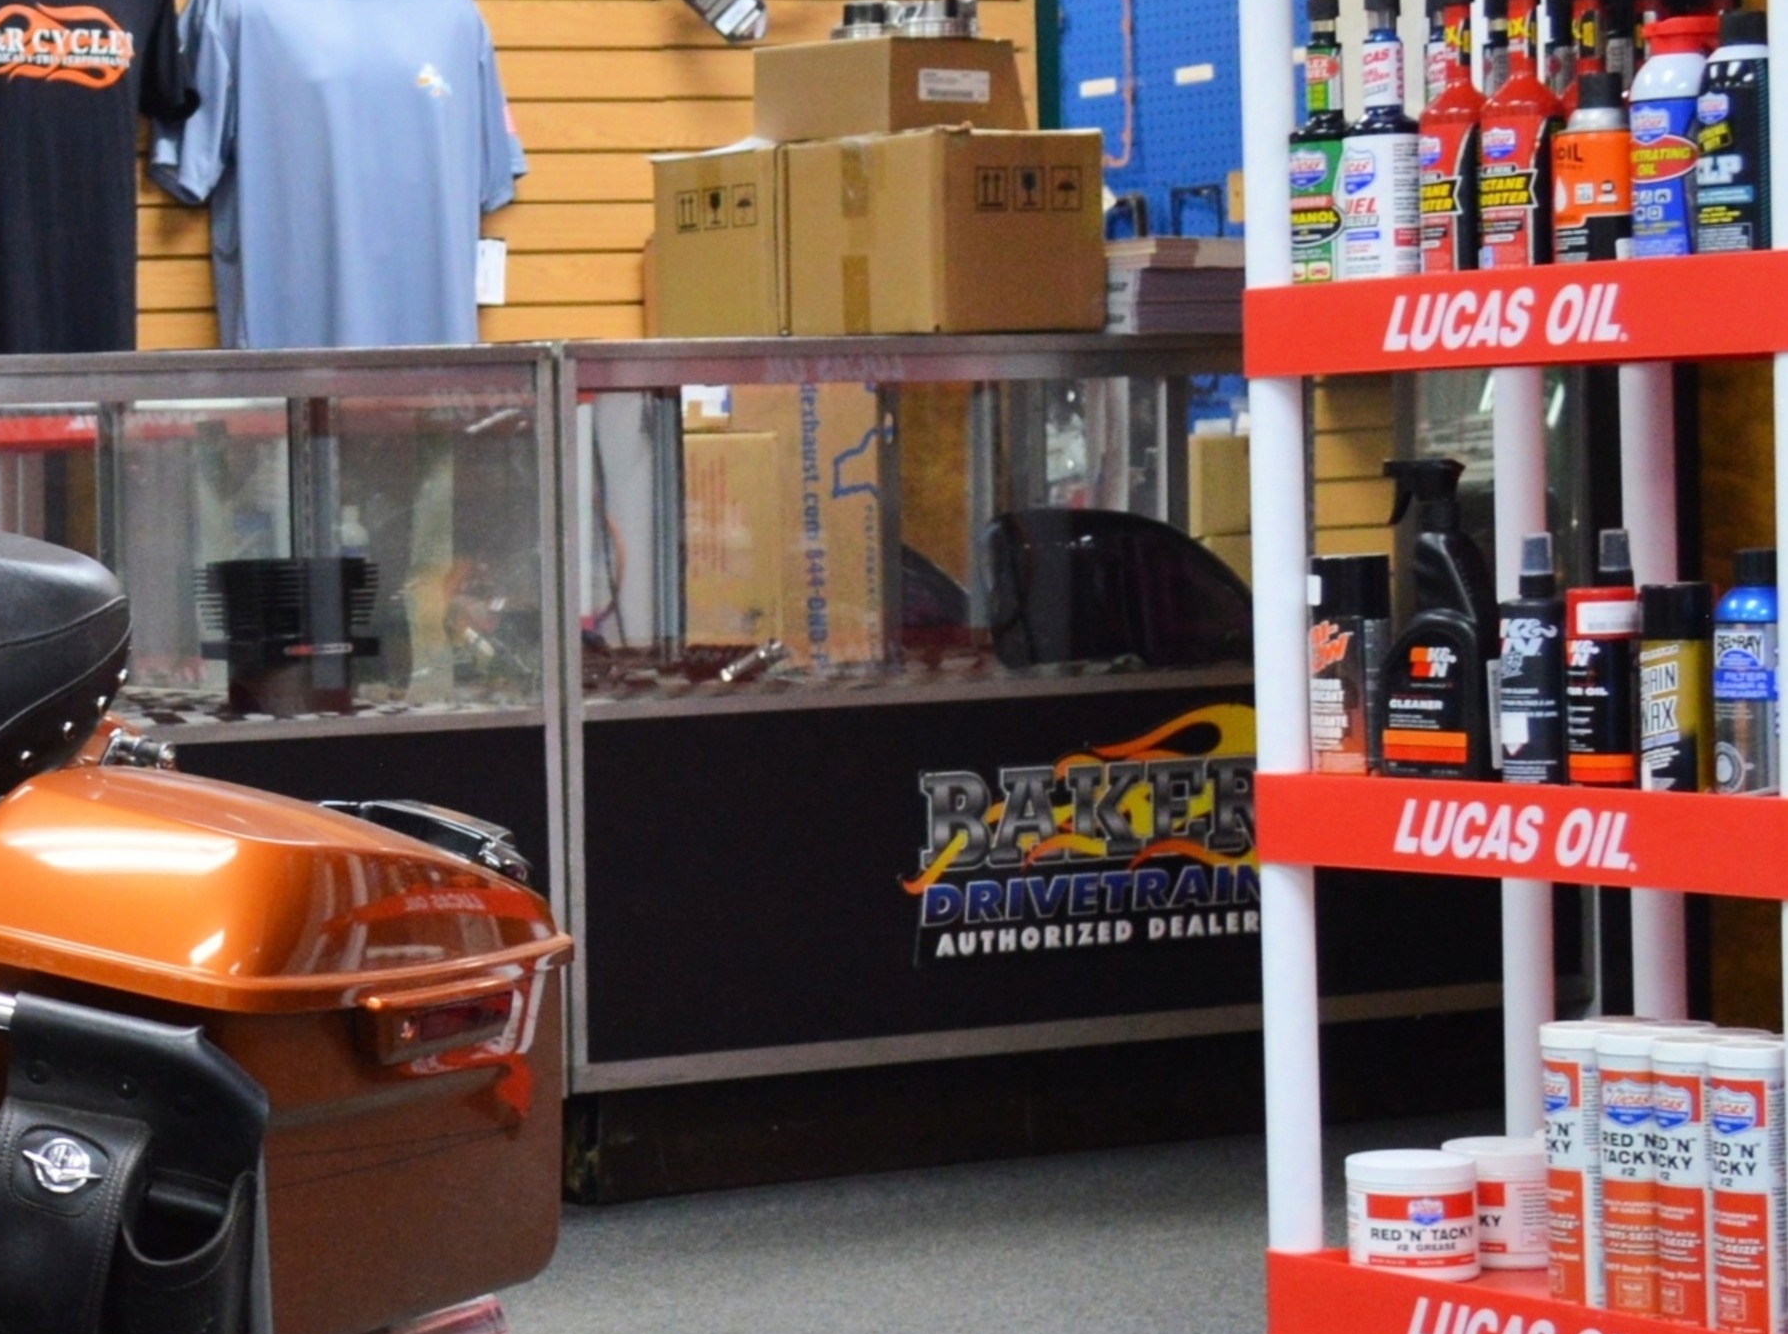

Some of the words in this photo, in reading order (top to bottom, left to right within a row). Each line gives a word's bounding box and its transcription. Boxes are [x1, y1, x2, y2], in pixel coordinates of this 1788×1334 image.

[1555, 144, 1583, 162] OIL
[1383, 286, 1534, 351] LUCAS
[1545, 283, 1622, 344] OIL
[1388, 699, 1444, 711] CLEANER
[918, 755, 1258, 872] BAKER
[1394, 800, 1543, 863] LUCAS
[1555, 809, 1630, 872] OIL
[921, 864, 1260, 927] DRIVETRAIN
[936, 919, 1133, 958] AUTHORIZED
[1148, 911, 1260, 941] DEALER
[1370, 1226, 1403, 1242] RED
[1431, 1225, 1474, 1241] TACKY
[1415, 1241, 1457, 1253] GREASE
